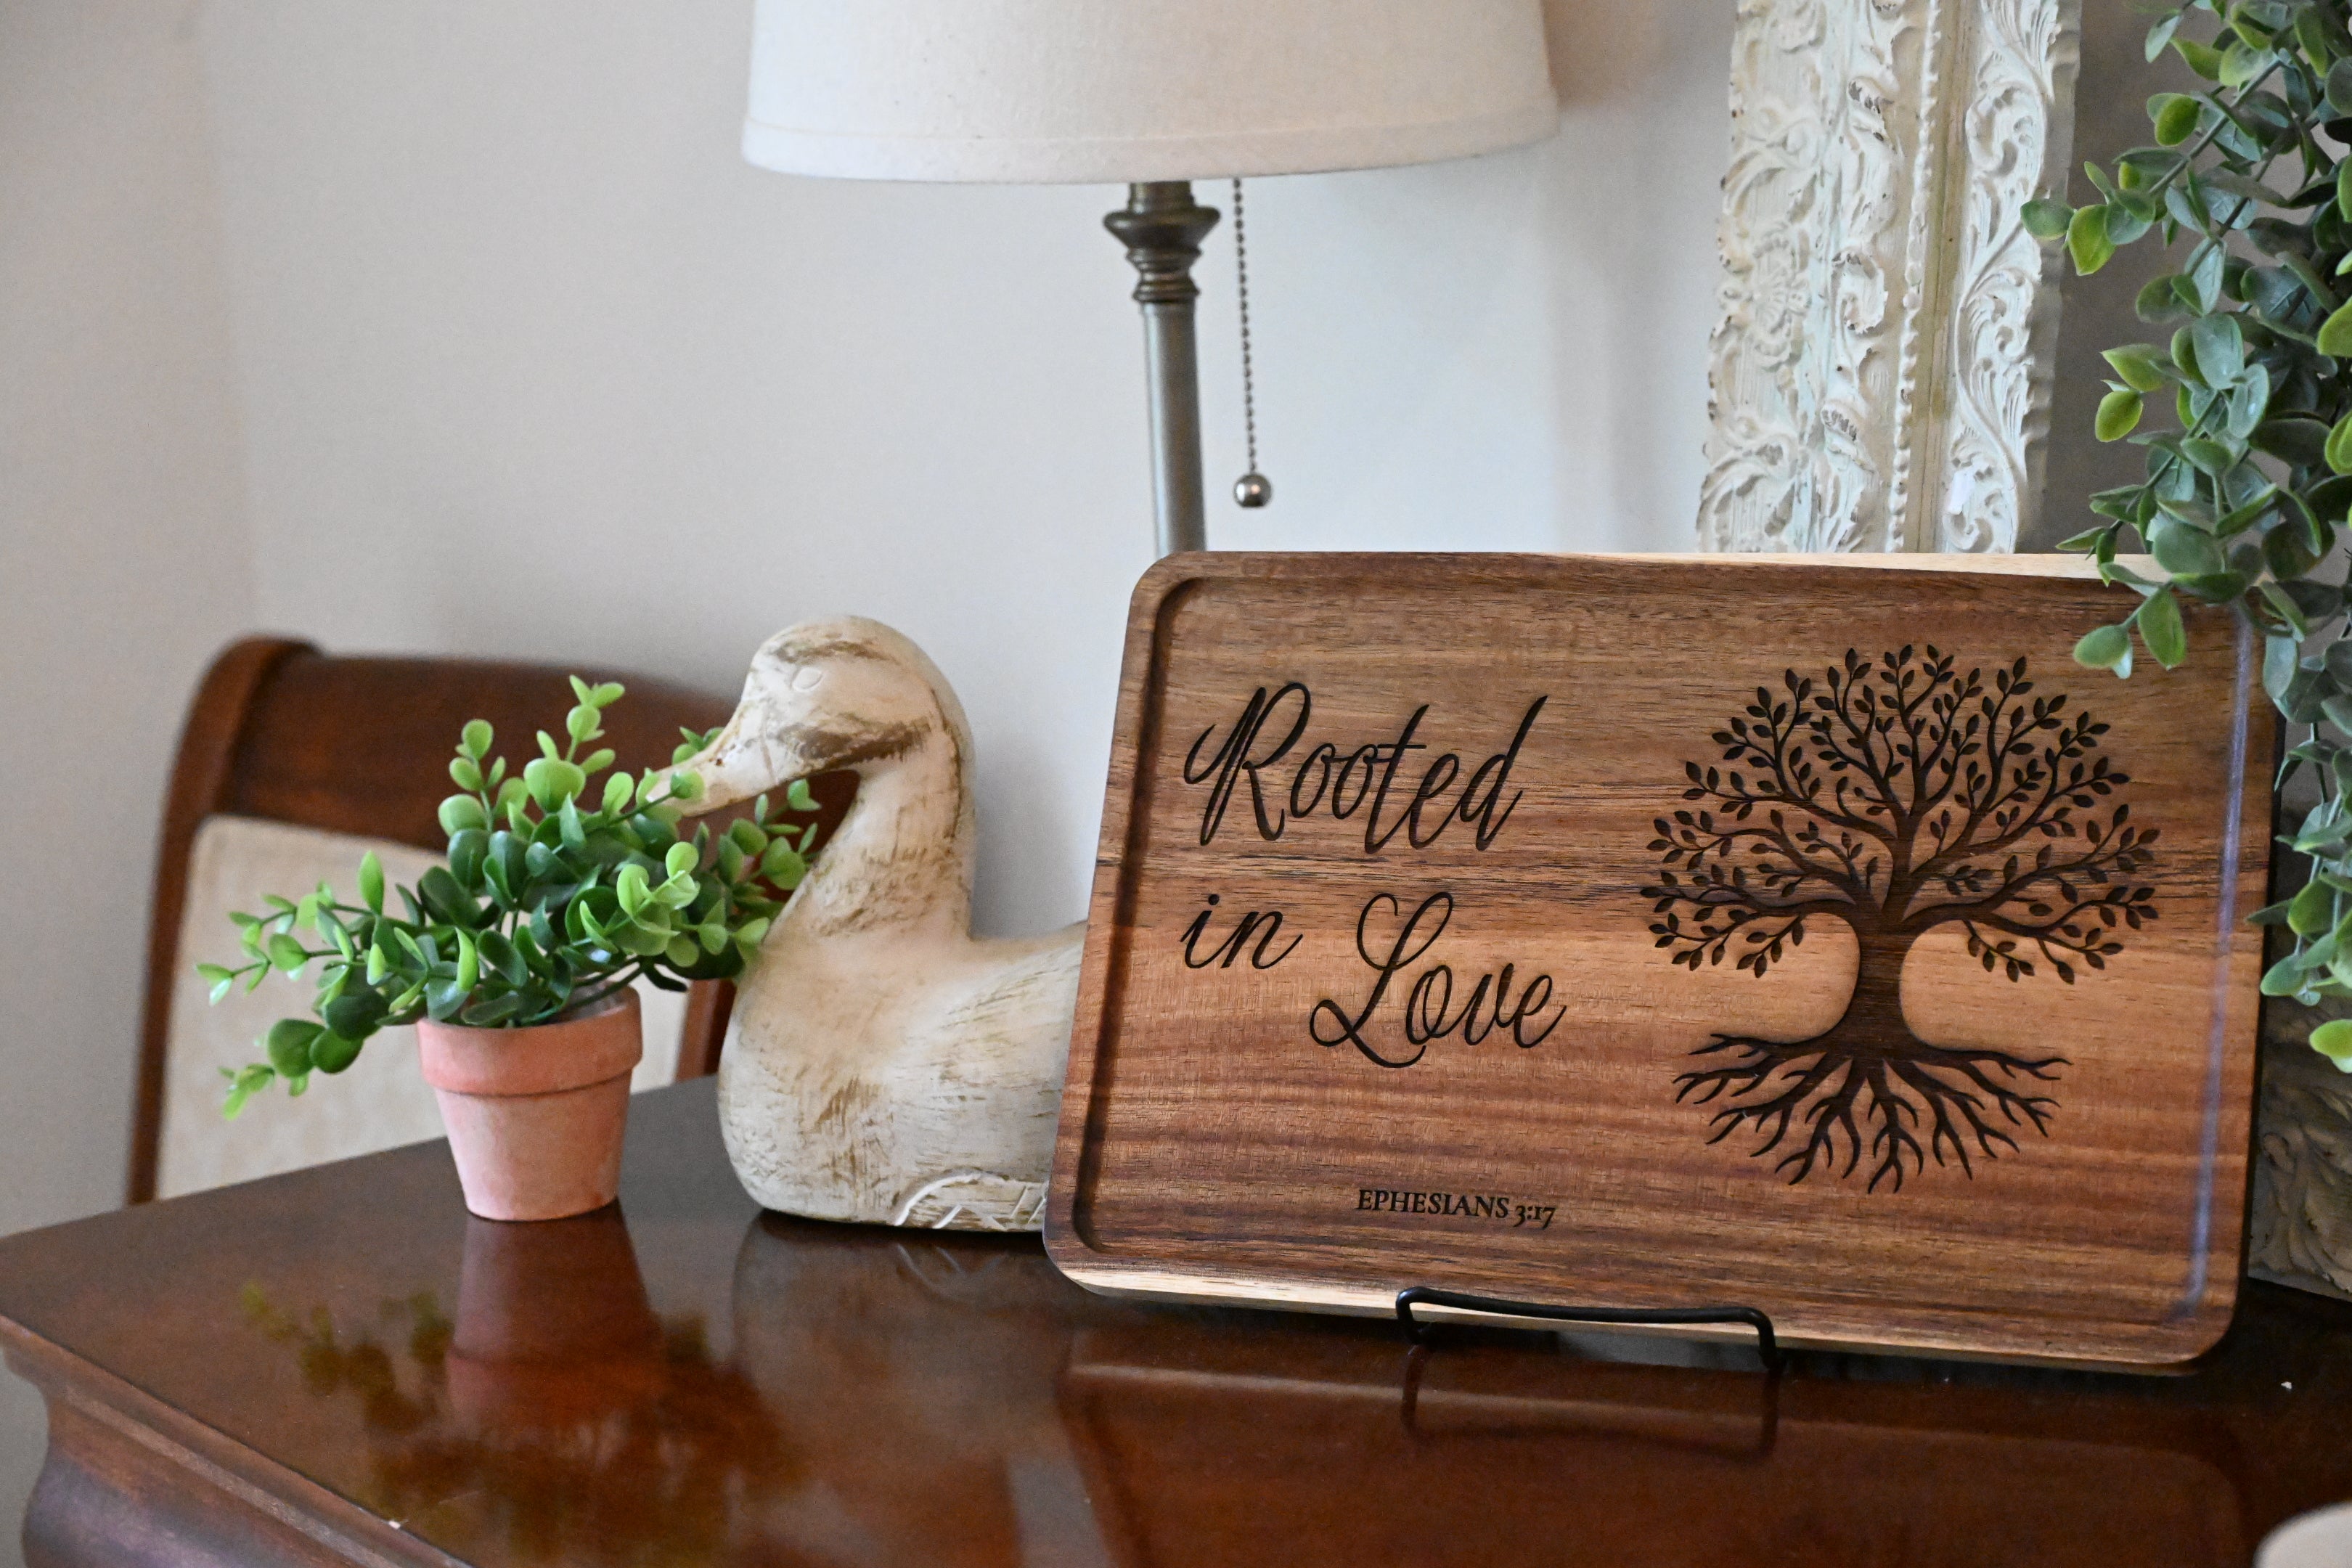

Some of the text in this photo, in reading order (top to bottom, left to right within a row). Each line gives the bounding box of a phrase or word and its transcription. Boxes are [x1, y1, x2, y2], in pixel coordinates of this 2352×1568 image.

[1183, 682, 1548, 854] Rooted
[1180, 891, 1567, 1069] in Love
[1356, 1189, 1557, 1230] EPHESIANS 3:17
